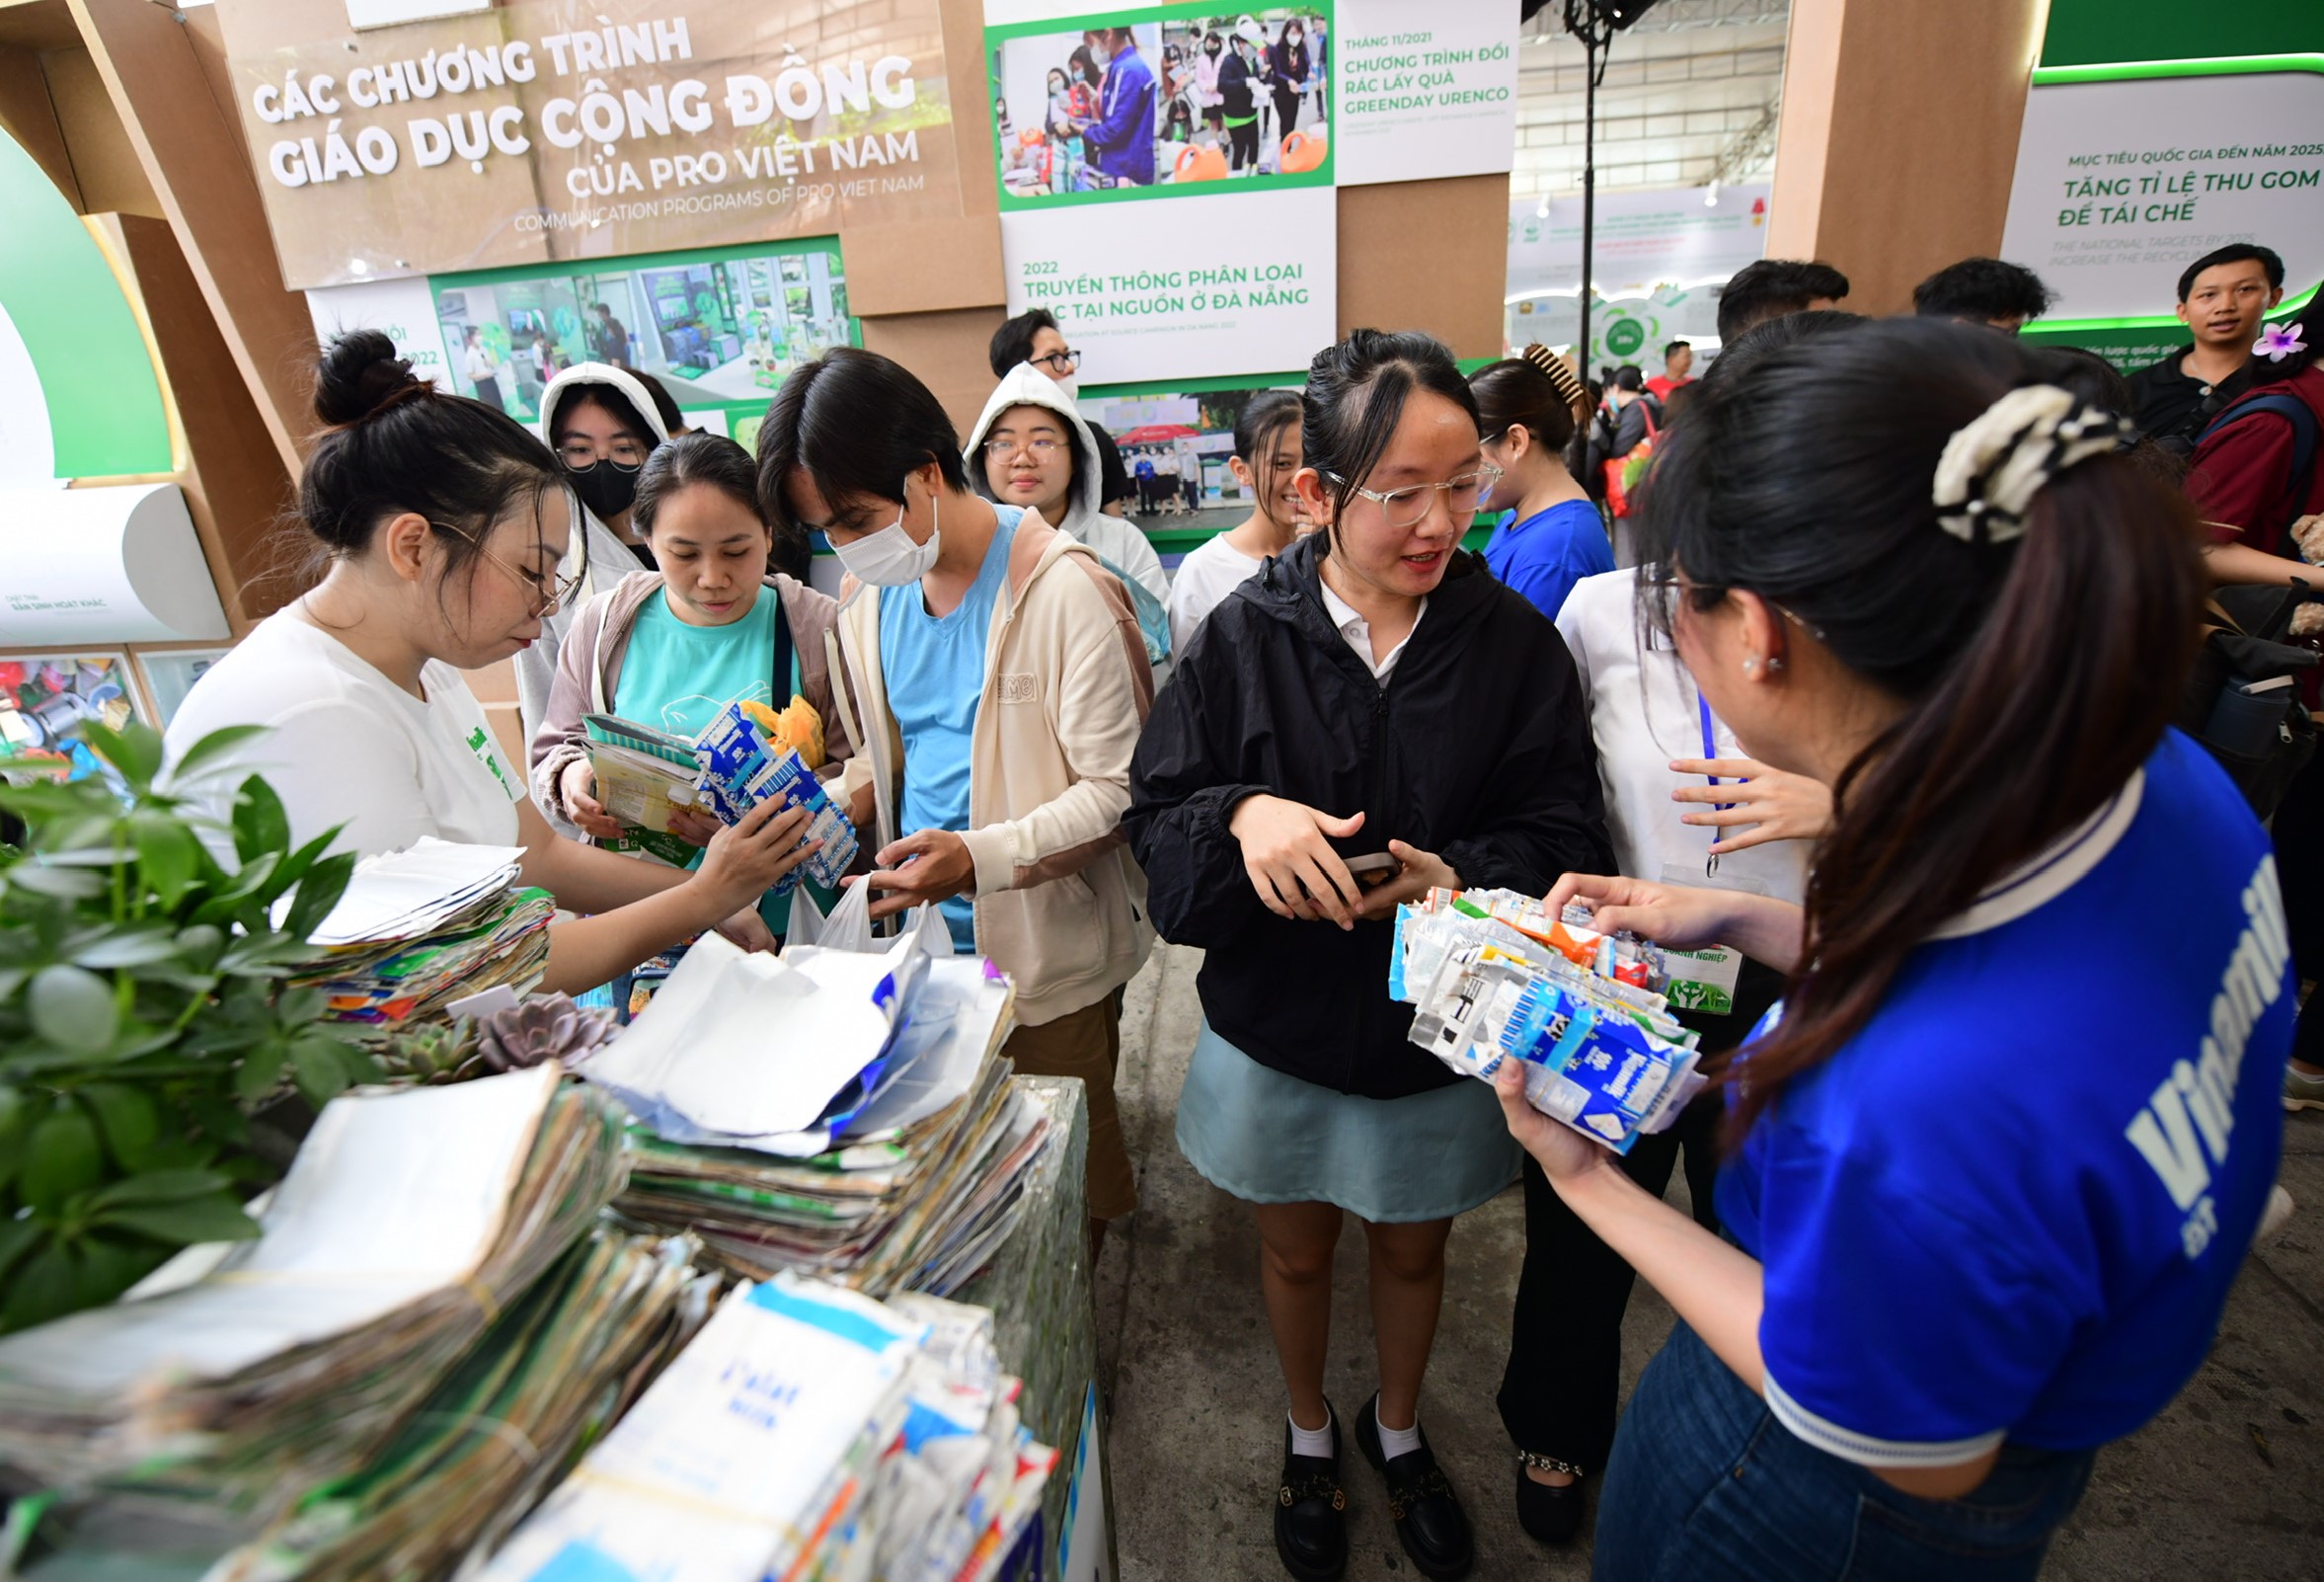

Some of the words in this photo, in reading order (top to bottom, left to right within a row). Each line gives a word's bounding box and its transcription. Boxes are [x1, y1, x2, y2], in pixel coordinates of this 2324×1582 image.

[1345, 35, 1388, 50] THÁNG
[1392, 32, 1433, 45] 11/2021
[253, 69, 341, 123] CÁC
[347, 40, 536, 109] CHƯƠNG
[541, 15, 692, 76] TRÌNH
[1345, 54, 1418, 74] CHƯƠNG
[1423, 47, 1473, 66] TRÌNH
[1345, 75, 1378, 94] RÁC
[1383, 71, 1414, 91] LẤY
[1418, 68, 1455, 90] QUÀ
[269, 118, 398, 188] GIÁO
[407, 106, 531, 175] DỤC
[541, 78, 713, 157] CỘNG
[725, 42, 915, 127] ĐỒNG
[1345, 95, 1434, 115] GREENDAY
[567, 153, 644, 198] CỦA
[650, 150, 728, 191] PRO
[735, 134, 818, 186] VIỆT
[829, 129, 920, 172] NAM
[2068, 154, 2101, 169] MỤC
[2106, 151, 2137, 165] TIÊU
[2141, 147, 2185, 165] QUỐC
[2188, 149, 2213, 161] GIA
[2217, 144, 2248, 160] ĐẾN
[2252, 143, 2286, 158] NĂM
[2064, 175, 2131, 198] TĂNG
[2139, 170, 2162, 196] TỈ
[2167, 170, 2197, 198] LỆ
[2204, 172, 2254, 193] THU
[2260, 169, 2321, 190] GOM
[514, 202, 659, 233] COMMUNICATION
[663, 190, 763, 216] PROGRAMS
[767, 187, 792, 204] OF
[797, 183, 835, 202] PRO
[839, 178, 879, 198] VIET
[883, 175, 924, 195] NAM
[2099, 201, 2138, 224] TÁI
[2144, 196, 2200, 222] CHẾ
[1023, 261, 1059, 276] 2022
[1024, 273, 1104, 298] TRUYỀN
[1109, 270, 1183, 293] THÔNG
[1188, 265, 1247, 287] PHÂN
[1254, 263, 1303, 285] LOẠI
[1071, 302, 1104, 322] TẠI
[1111, 292, 1185, 317] NGUỒN
[1191, 290, 1207, 311] Ở
[1212, 289, 1243, 309] ĐÀ
[1249, 283, 1309, 307] NẴNG
[1695, 951, 1728, 964] NGHIỆP
